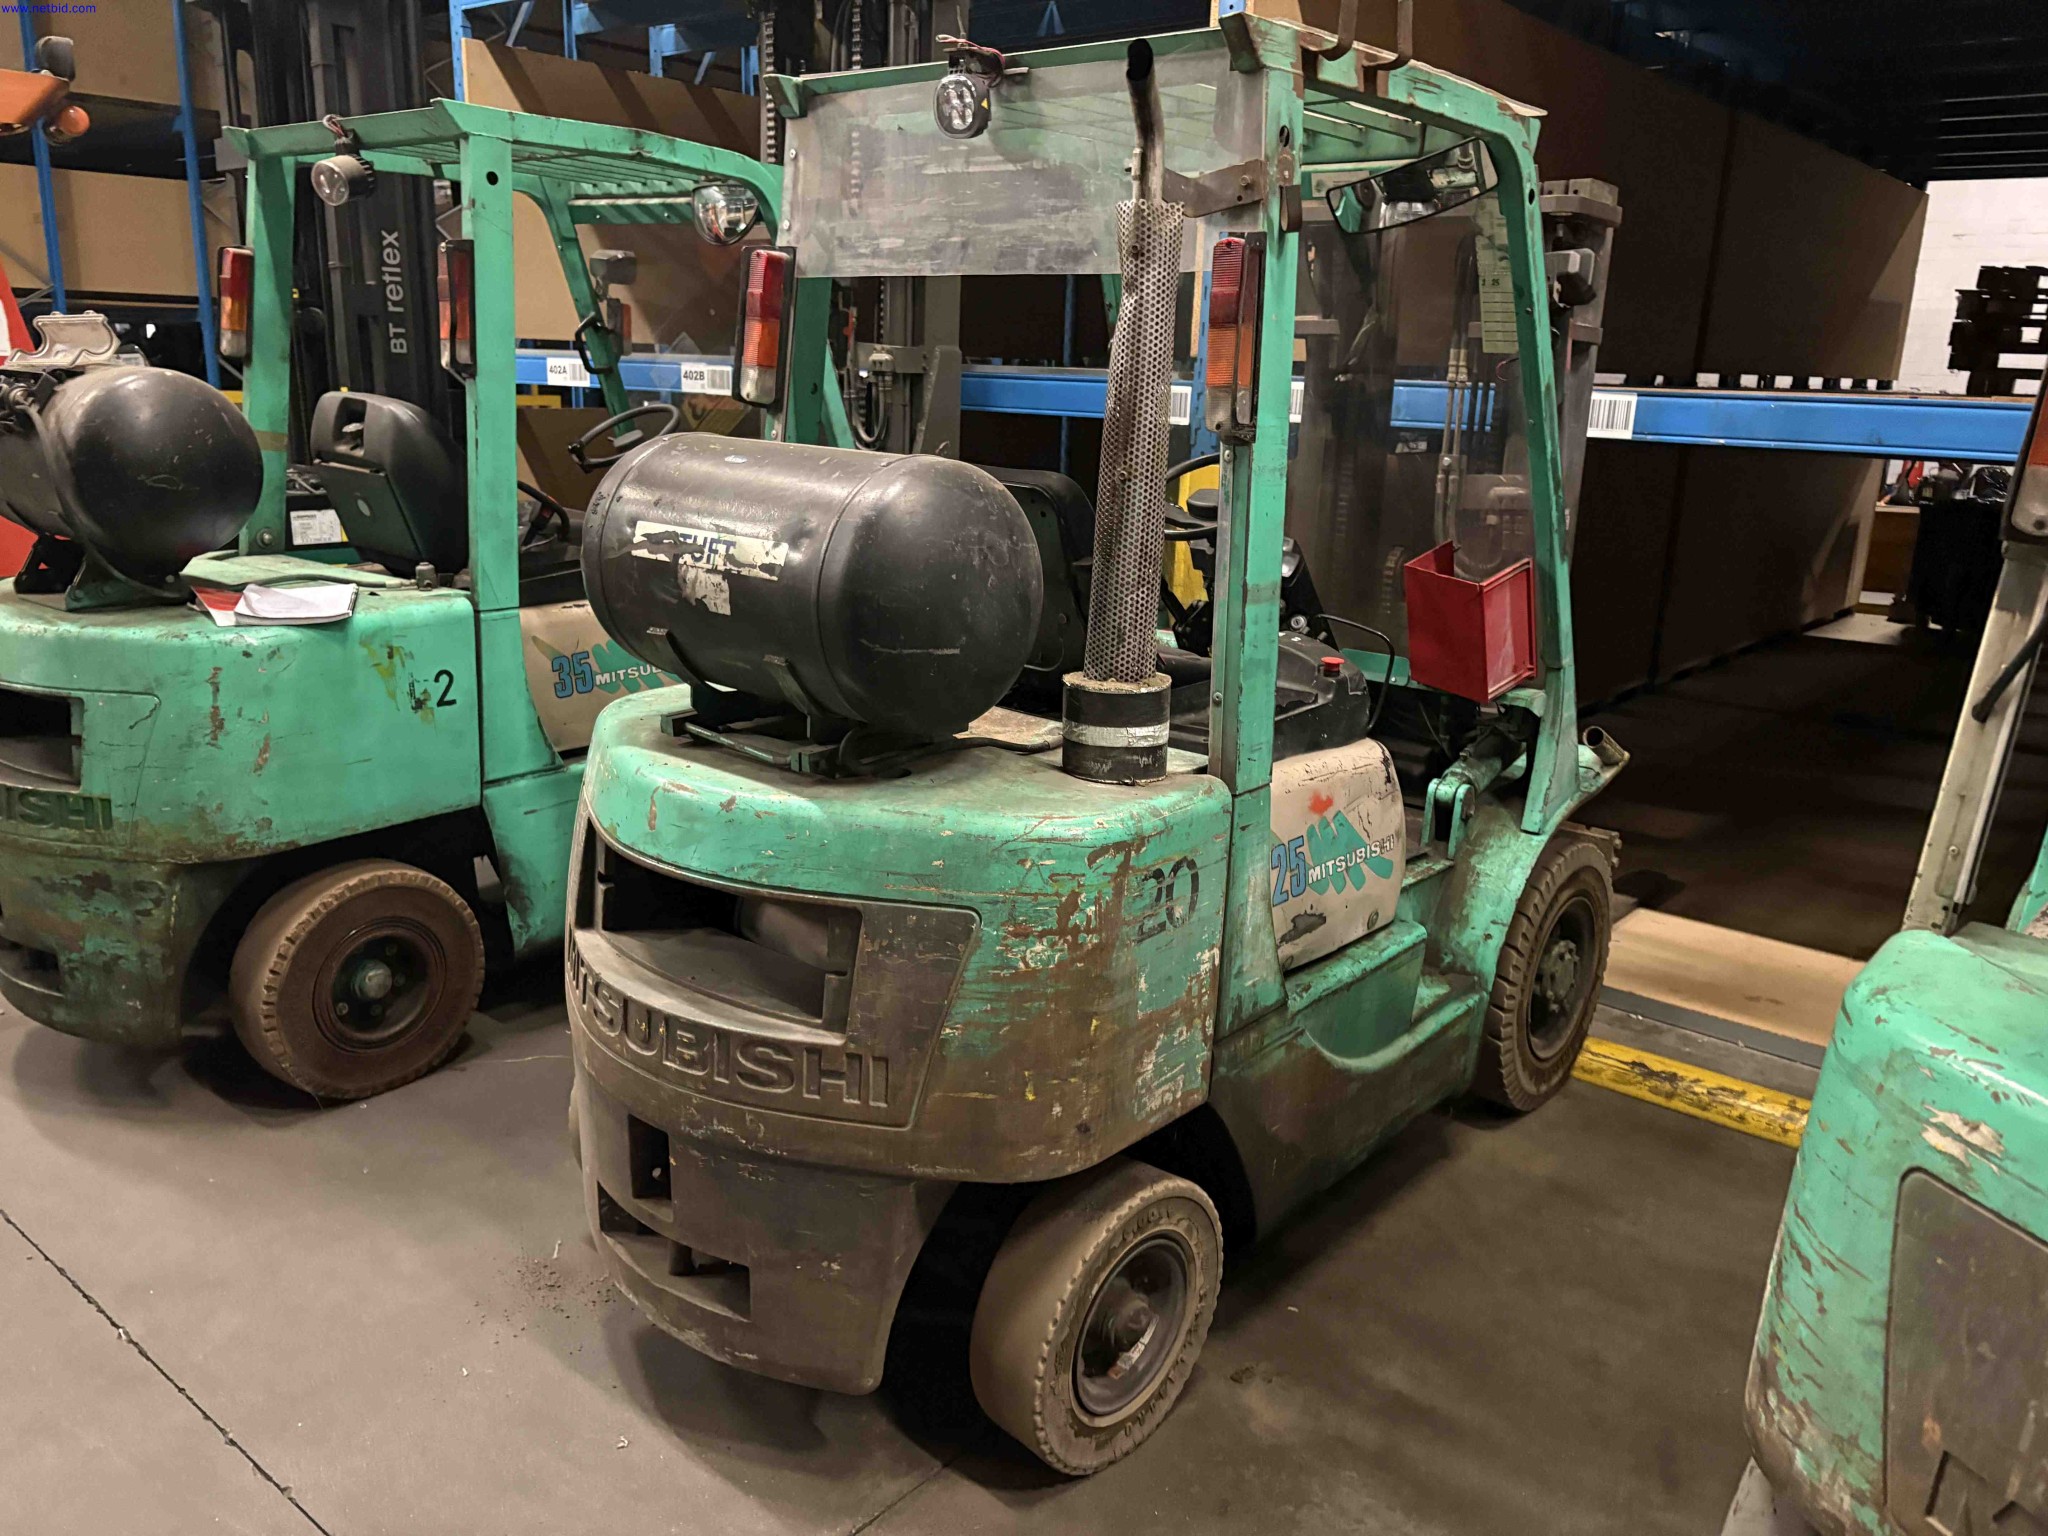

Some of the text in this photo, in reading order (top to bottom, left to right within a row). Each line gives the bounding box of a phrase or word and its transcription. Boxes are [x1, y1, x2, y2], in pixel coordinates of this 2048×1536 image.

[388, 323, 408, 353] BT
[549, 364, 568, 375] 402A
[682, 369, 706, 381] 402B
[551, 651, 595, 699] 35
[1271, 834, 1395, 908] 25 MITSUBISHI
[566, 922, 889, 1108] MITSUBISHI
